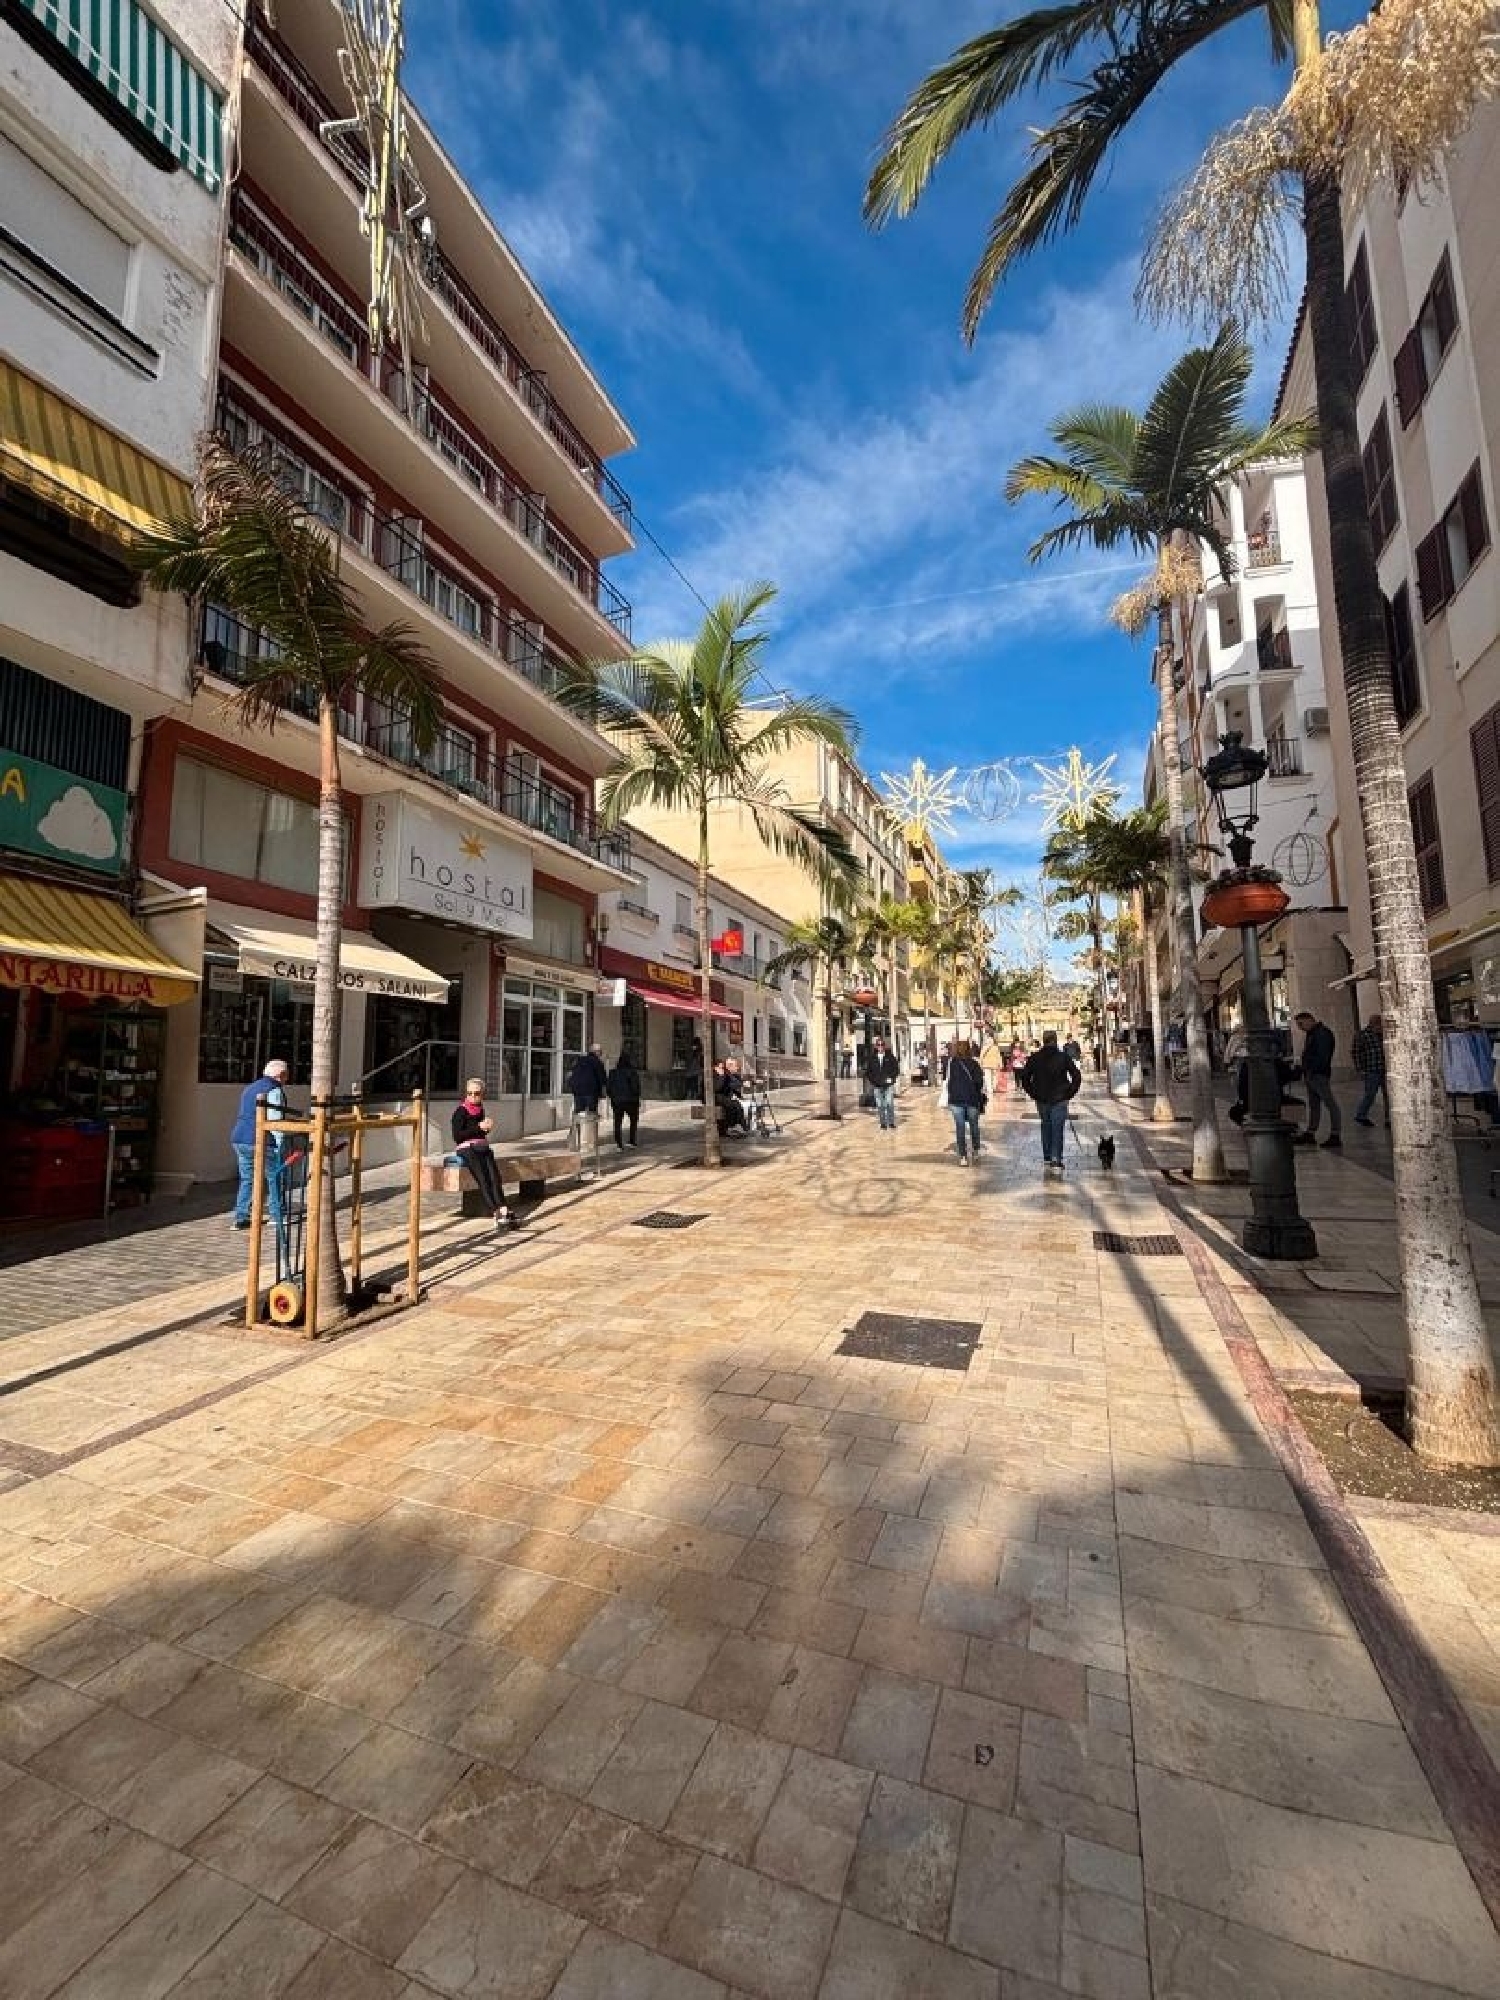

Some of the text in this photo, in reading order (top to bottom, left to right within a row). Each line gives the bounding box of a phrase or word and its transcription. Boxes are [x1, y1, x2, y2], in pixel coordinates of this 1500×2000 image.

[410, 845, 525, 910] hostal
[273, 960, 428, 999] CALZOS SALANI
